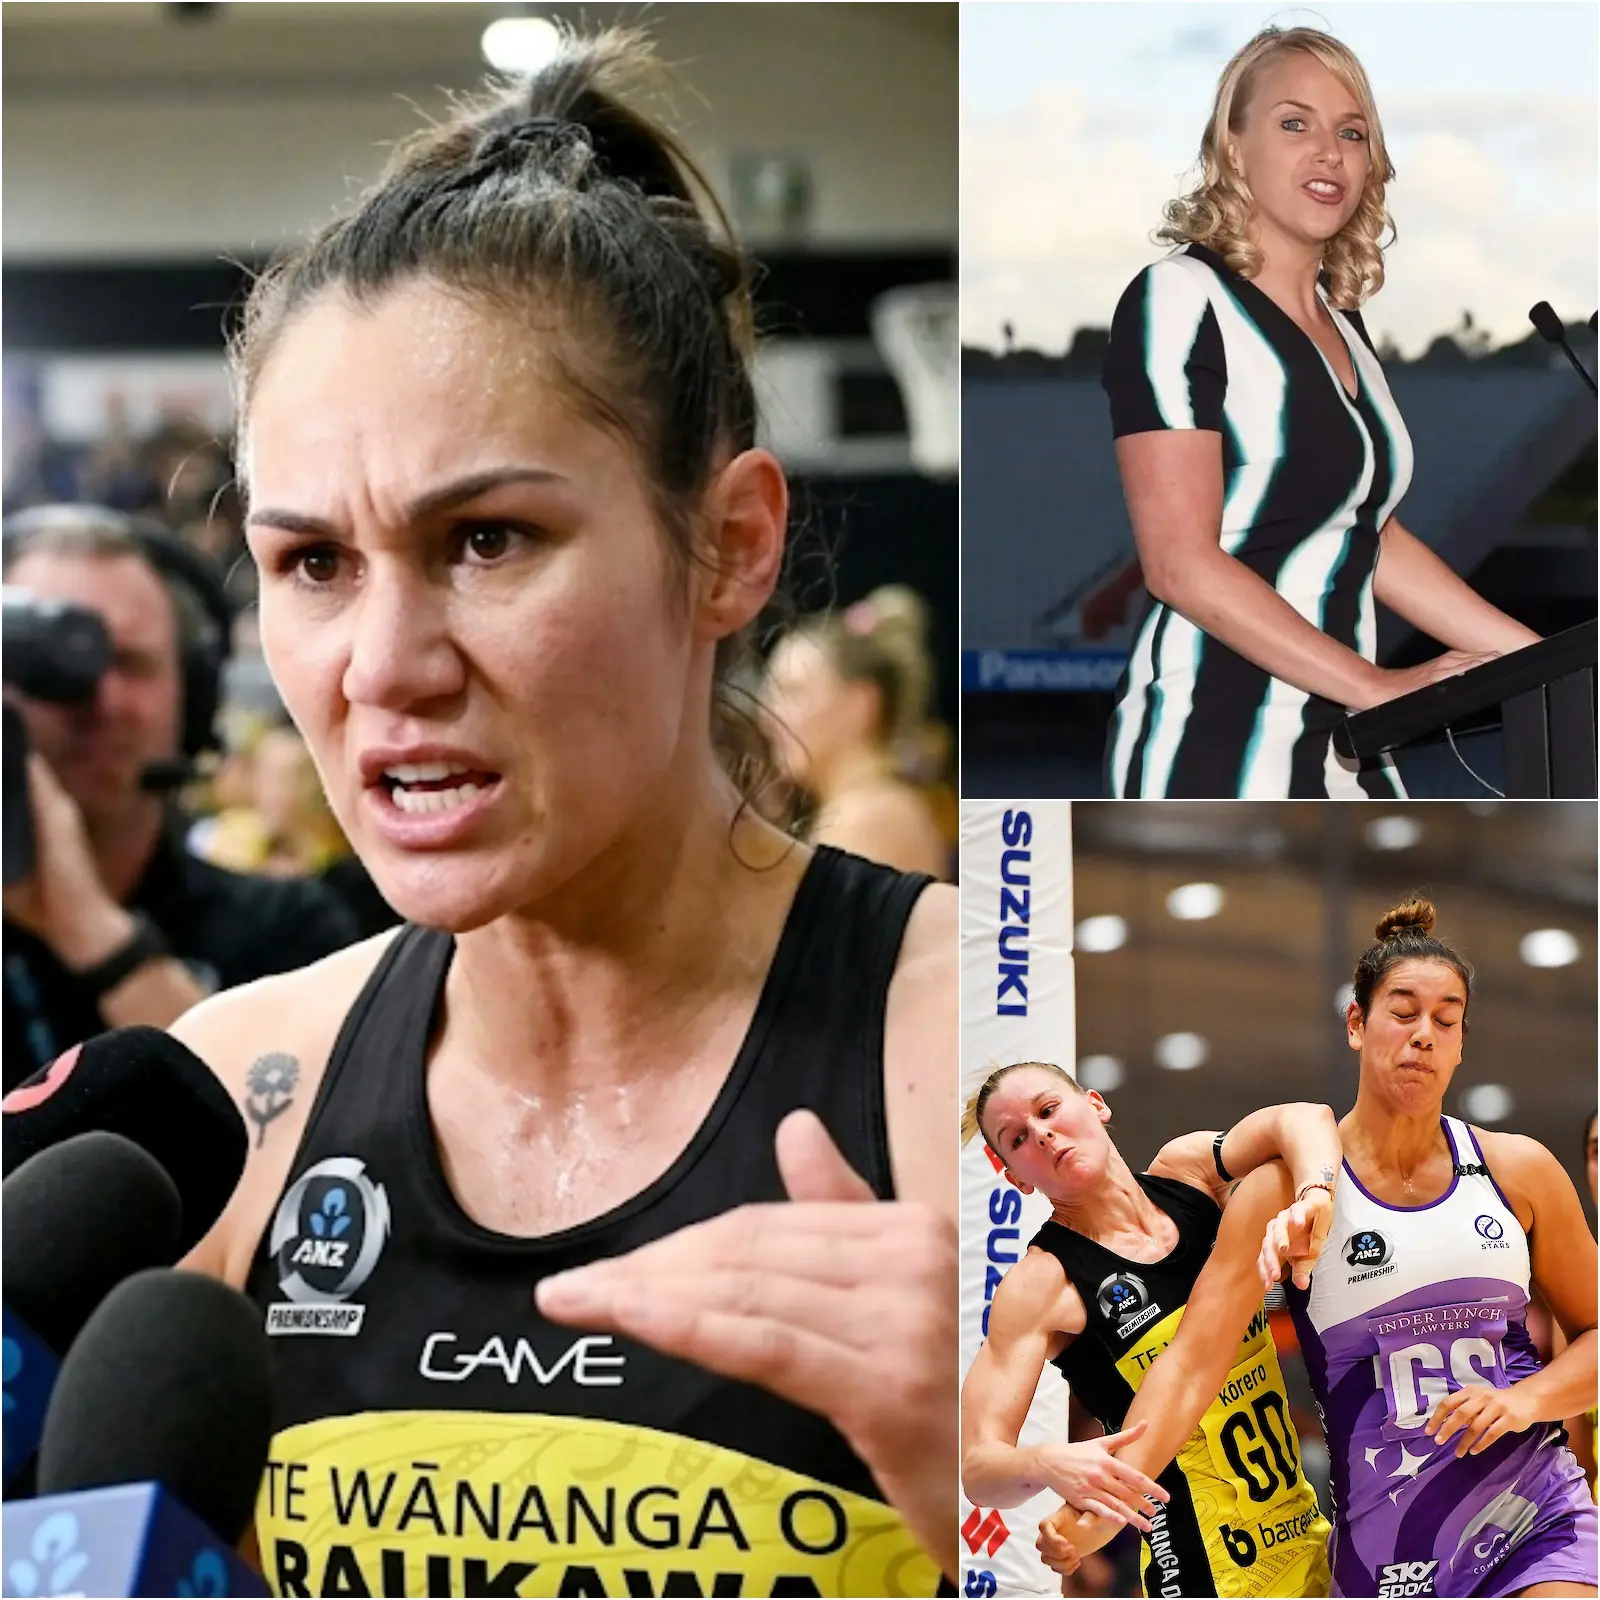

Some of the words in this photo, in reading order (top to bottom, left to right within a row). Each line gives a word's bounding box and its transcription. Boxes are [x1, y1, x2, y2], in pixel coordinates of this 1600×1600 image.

[979, 651, 1126, 689] Panaso
[997, 809, 1032, 1017] SUZUKI
[291, 1239, 349, 1267] ANZ
[1354, 1247, 1381, 1261] ANZ
[1347, 1265, 1395, 1285] PREMIERSHIP
[1118, 1295, 1137, 1312] ANZ
[1120, 1305, 1158, 1337] PREMIERSHIP
[1378, 1312, 1435, 1335] INDER
[1442, 1307, 1502, 1321] LYNCH
[1412, 1321, 1471, 1336] LAWYERS
[419, 1332, 625, 1386] GAME
[1220, 1390, 1298, 1503] GD
[265, 1462, 309, 1522] TE
[330, 1462, 751, 1552] WĀNANGA
[779, 1488, 848, 1556] O
[1380, 1560, 1439, 1585] SKY
